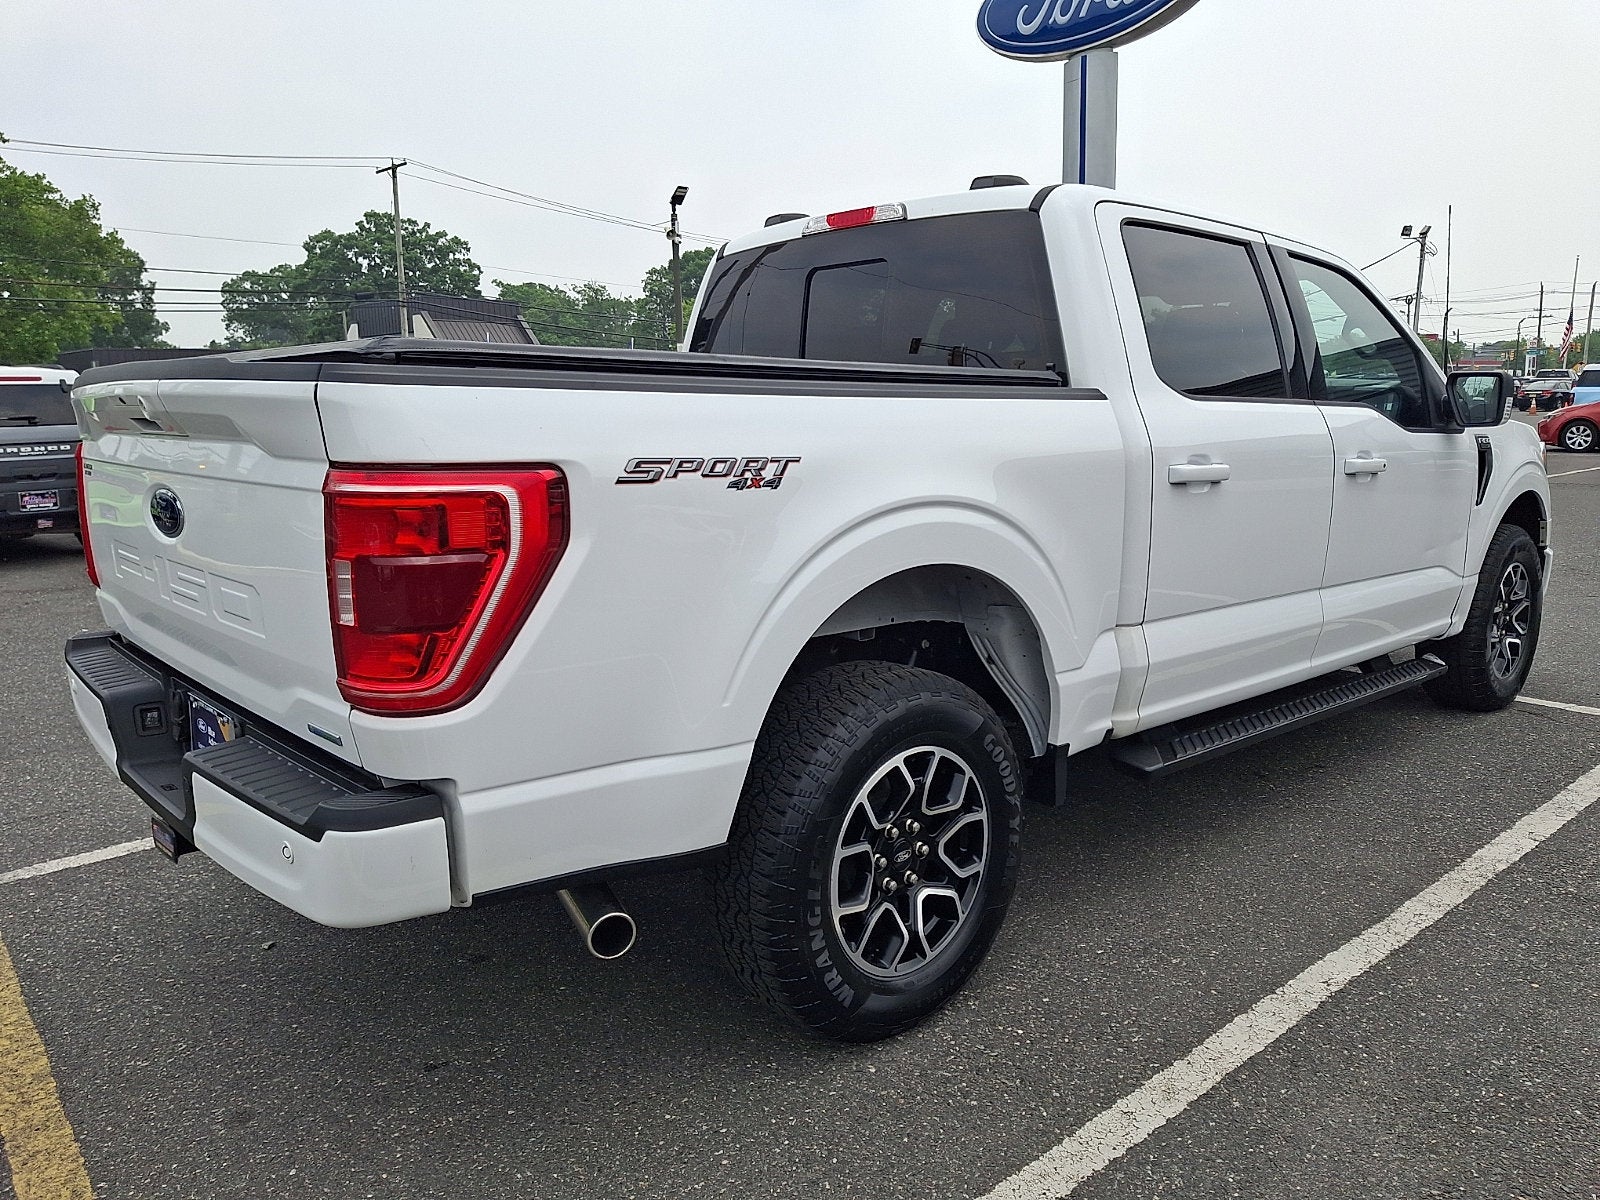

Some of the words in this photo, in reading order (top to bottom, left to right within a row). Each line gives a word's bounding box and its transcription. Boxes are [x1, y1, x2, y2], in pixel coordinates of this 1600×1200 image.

[614, 456, 802, 485] SPORT
[110, 538, 267, 640] F-150
[807, 859, 856, 1008] WRANGLE
